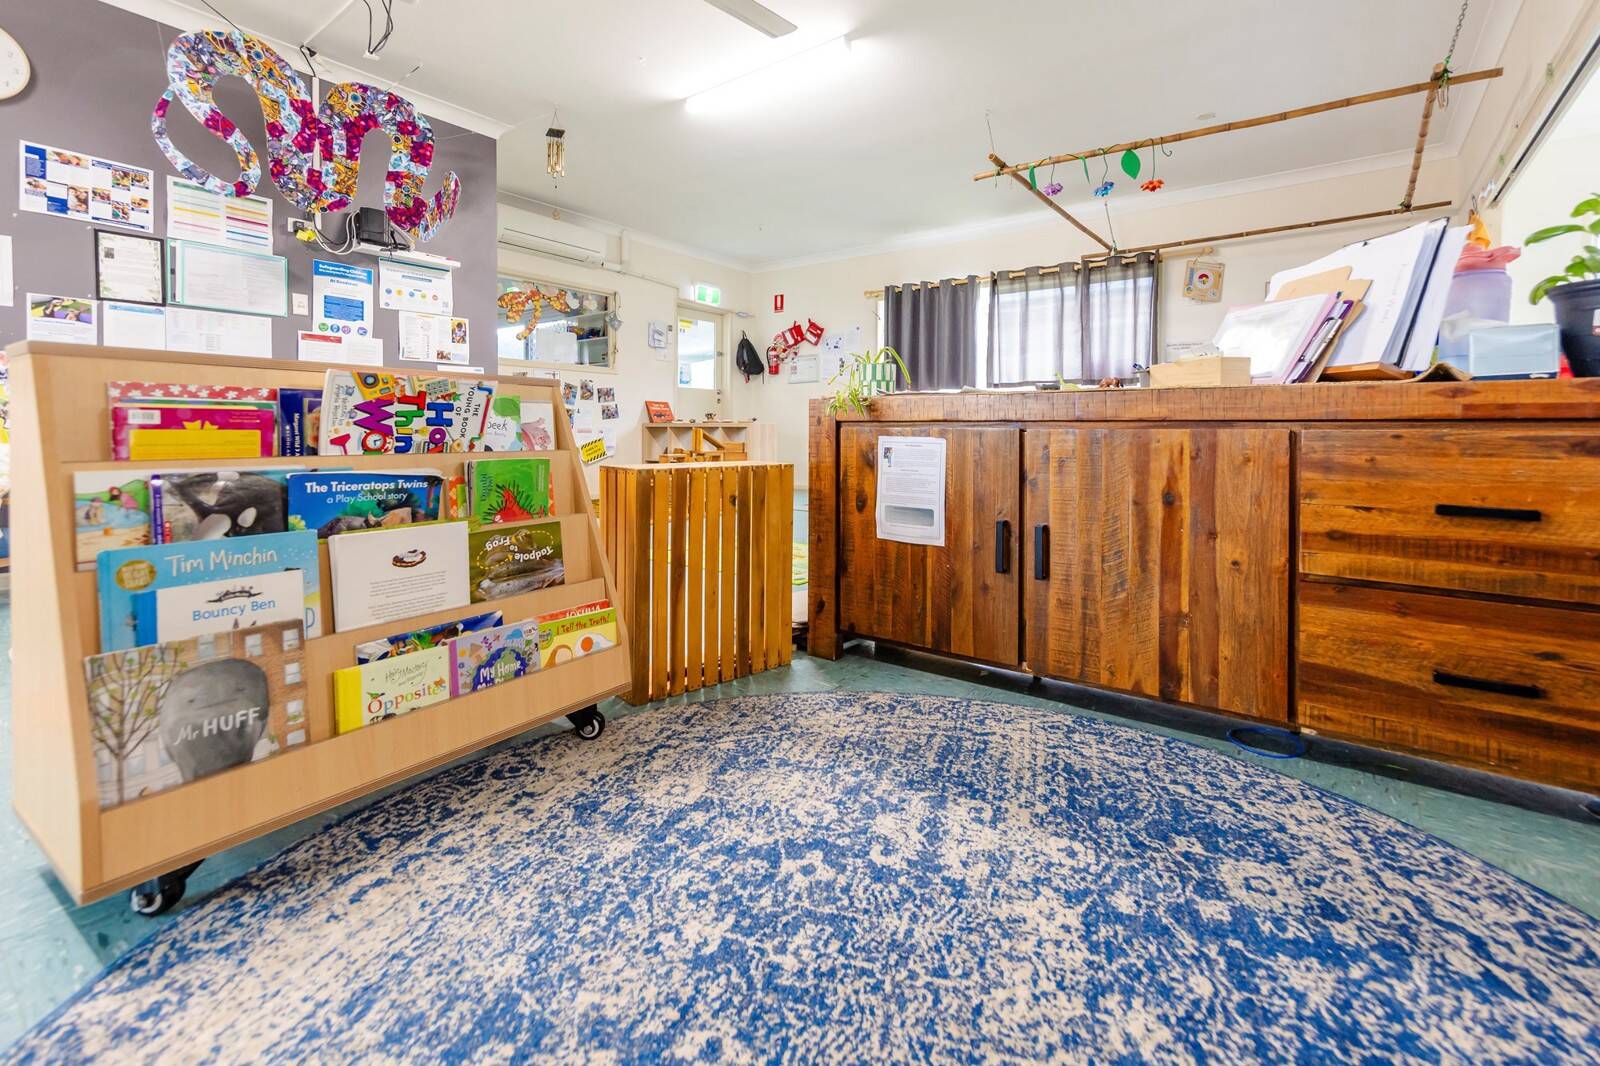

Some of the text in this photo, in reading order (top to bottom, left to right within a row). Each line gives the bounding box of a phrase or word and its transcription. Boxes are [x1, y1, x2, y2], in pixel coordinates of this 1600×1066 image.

[455, 406, 462, 416] OF
[460, 386, 477, 439] YOUNG BOOK
[472, 403, 480, 417] THE
[305, 479, 429, 493] The Triceratops Twins
[335, 494, 355, 504] Play
[357, 492, 387, 502] School
[387, 492, 408, 502] story
[485, 536, 511, 551] Frog
[509, 544, 518, 552] to
[164, 554, 204, 577] Tim
[209, 546, 278, 571] Minchin
[514, 545, 554, 562] Tadpole
[192, 599, 276, 621] Bouncy Ben
[561, 622, 574, 633] Tell
[575, 620, 587, 629] the
[589, 613, 610, 626] Truth!
[480, 660, 521, 683] My Home
[367, 682, 448, 716] Opposites
[172, 706, 261, 745] Mr HUFF
